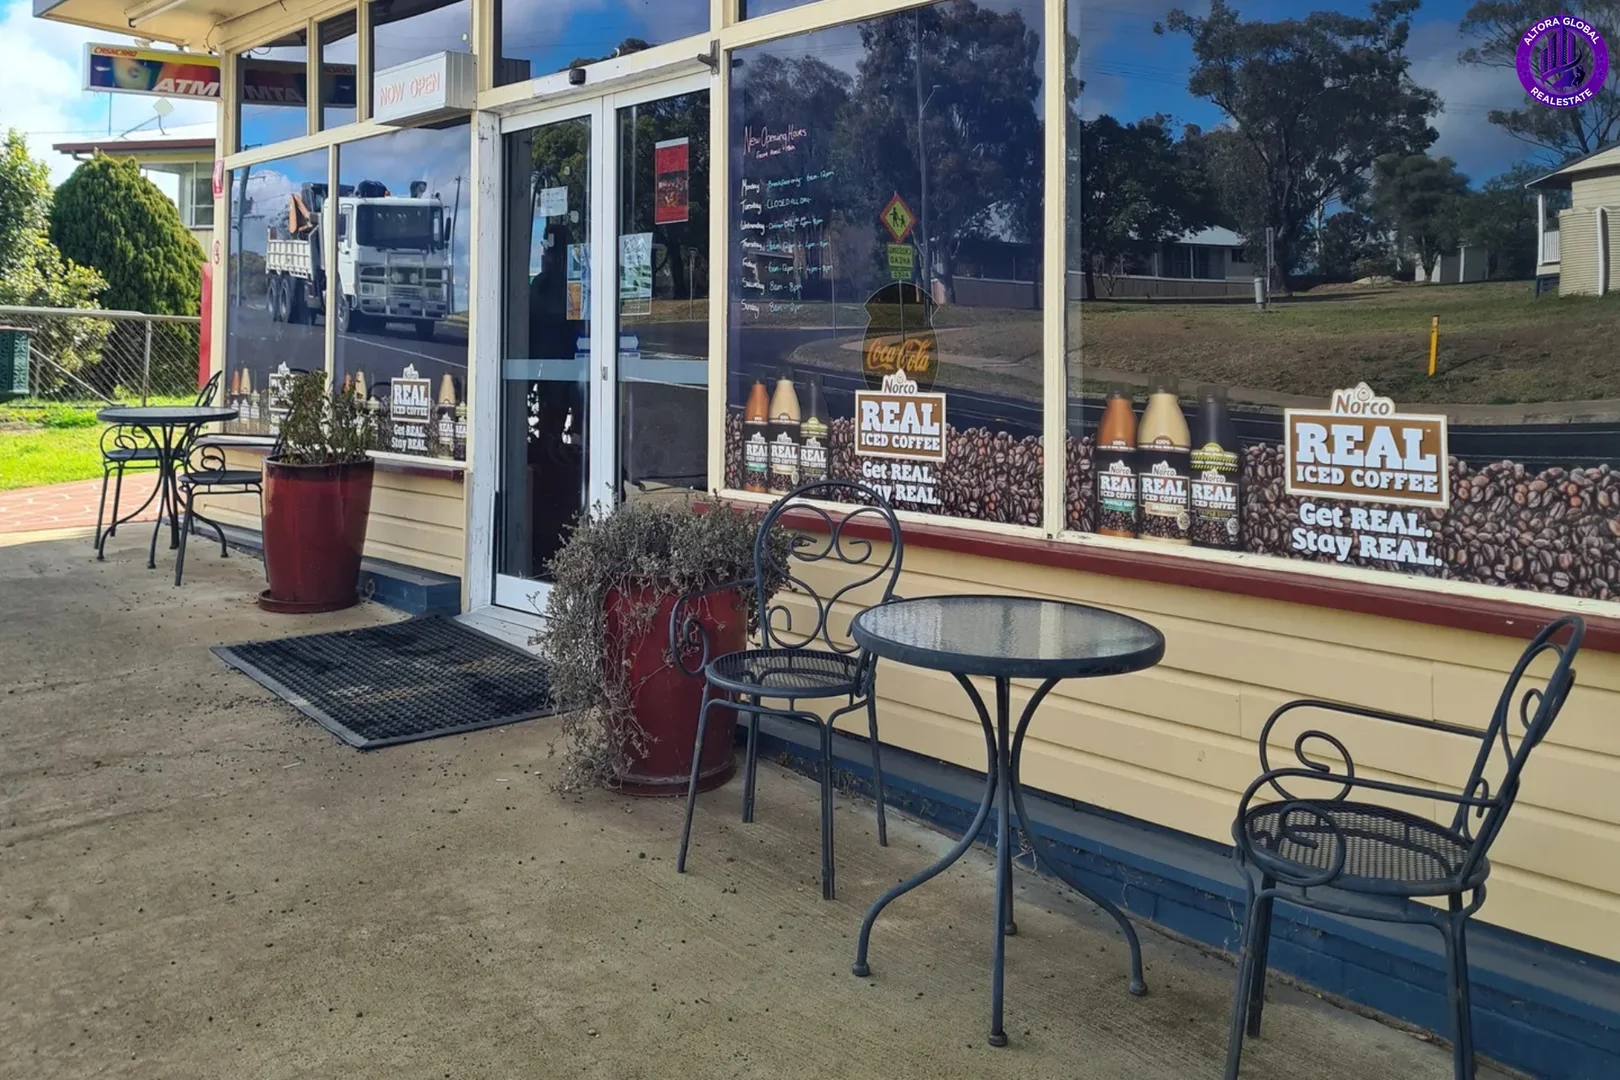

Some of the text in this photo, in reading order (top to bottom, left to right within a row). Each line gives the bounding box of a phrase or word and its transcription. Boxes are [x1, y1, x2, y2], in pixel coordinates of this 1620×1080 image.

[152, 78, 220, 96] ATM
[380, 72, 440, 106] NOW OPEN
[744, 126, 760, 155] New
[788, 124, 807, 141] Hours
[742, 179, 760, 196] Monday
[740, 199, 762, 214] Tuesday
[394, 384, 428, 406] REAL
[884, 378, 915, 394] Norco
[407, 406, 428, 416] COFFEE
[1336, 394, 1390, 415] Norco
[862, 400, 940, 436] REAL
[861, 432, 940, 451] ICED COFFEE
[1296, 422, 1437, 472] REAL
[771, 445, 797, 459] REAL
[800, 449, 826, 463] REAL
[862, 461, 936, 484] Get REAL.
[1111, 464, 1130, 475] Norco
[1154, 464, 1175, 476] Norco
[1203, 471, 1225, 483] Norco
[1296, 465, 1438, 493] ICED COFFEE
[895, 484, 942, 505] REAL.
[1142, 477, 1187, 496] REAL
[1192, 484, 1236, 503] REAL
[1142, 493, 1187, 504] ICED COFFEE
[1192, 498, 1236, 510] ICED COFFEE
[1300, 502, 1433, 538] Get REAL.
[1292, 528, 1443, 567] Stay REAL.
